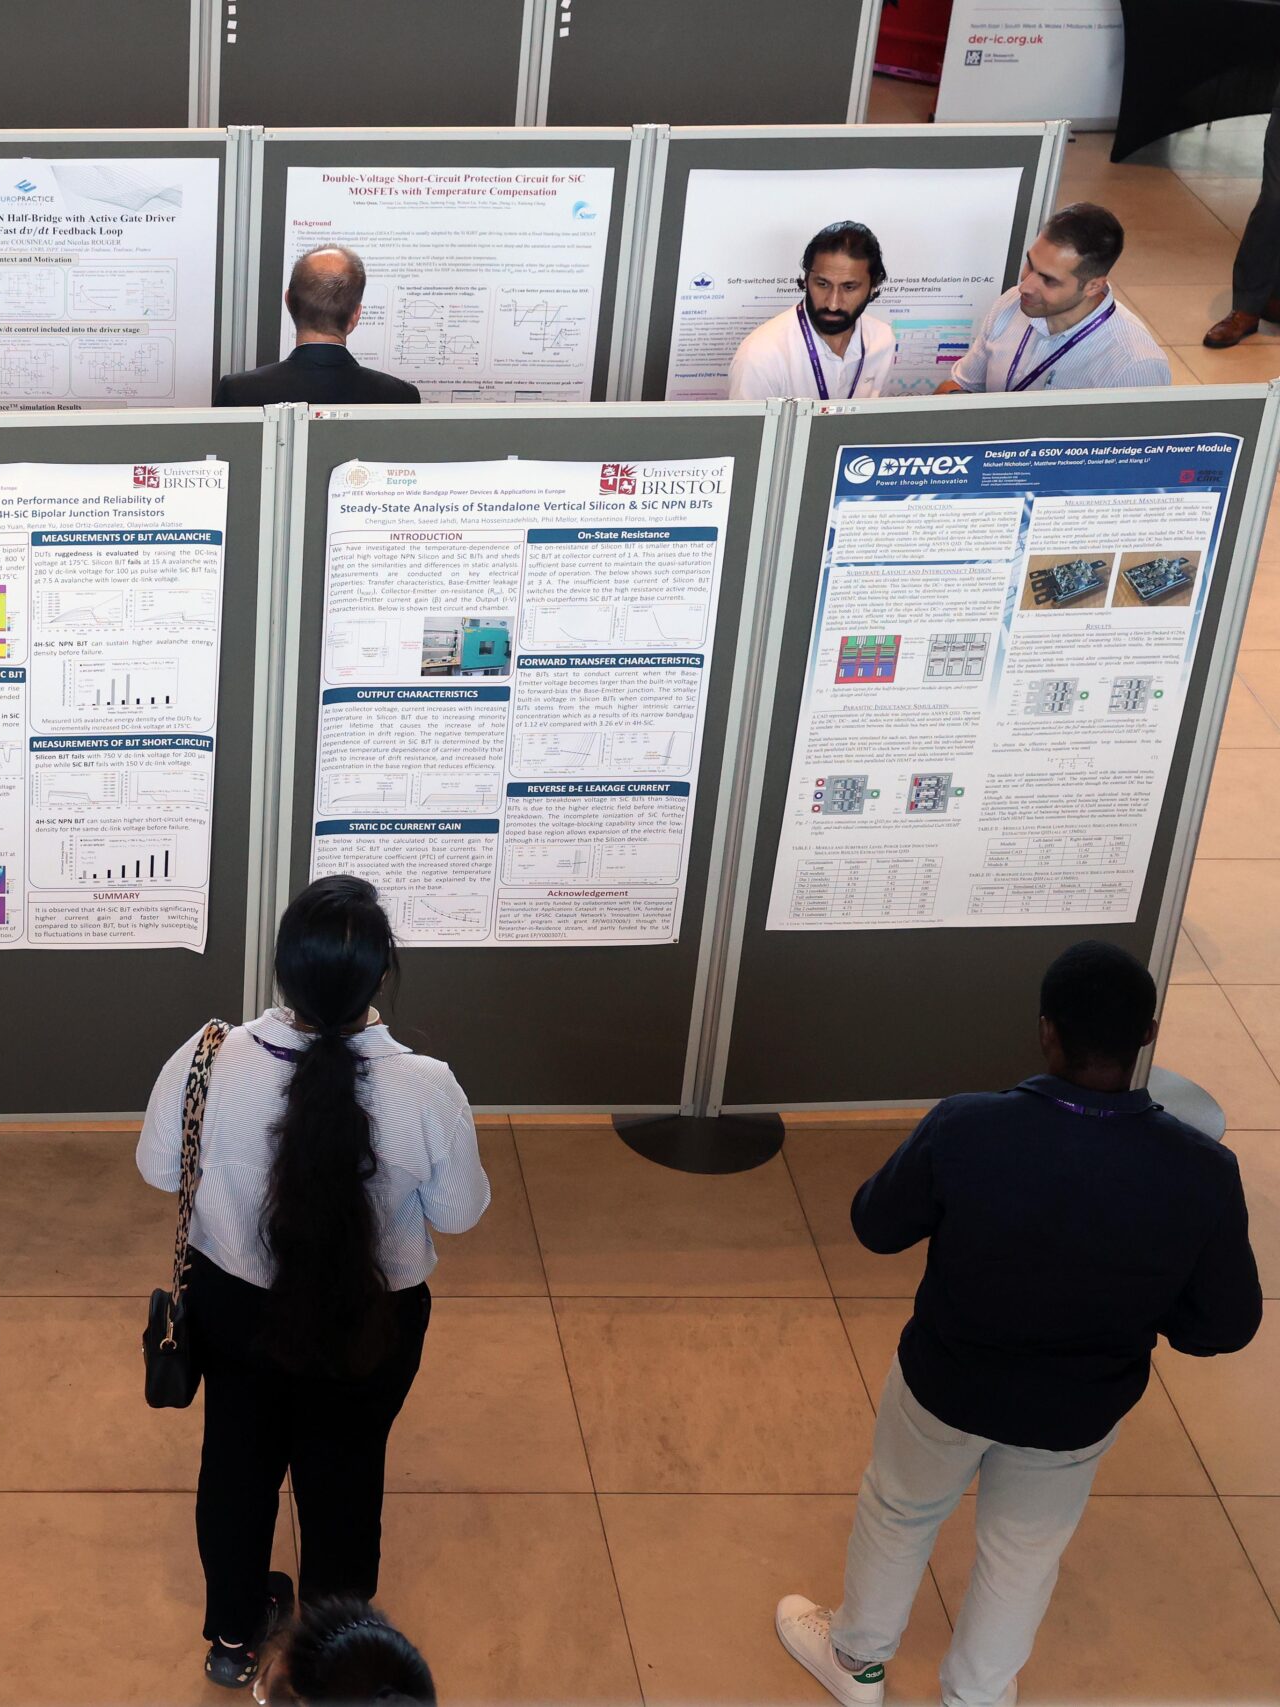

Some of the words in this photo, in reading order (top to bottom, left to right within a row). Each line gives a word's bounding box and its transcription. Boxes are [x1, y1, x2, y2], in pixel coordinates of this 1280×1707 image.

[968, 34, 1042, 45] der-ic.org.uk
[322, 174, 394, 184] Double-Voltage
[464, 174, 511, 182] Protection
[426, 187, 486, 196] Temperature
[489, 188, 556, 197] Compensation
[8, 214, 62, 223] Half-Bridge
[19, 226, 48, 235] dv/dt
[100, 227, 122, 236] Loop
[985, 450, 1016, 458] Design
[1091, 446, 1141, 455] Half-bridge
[1196, 444, 1231, 452] Module
[643, 467, 707, 479] University
[711, 465, 726, 476] of
[642, 480, 724, 494] BRISTOL
[17, 496, 79, 504] Performance
[103, 495, 151, 505] Reliability
[154, 495, 164, 503] of
[340, 503, 410, 514] Steady-State
[413, 502, 458, 513] Analysis
[462, 502, 474, 511] of
[477, 502, 539, 511] Standalone
[544, 501, 585, 510] Vertical
[589, 501, 624, 510] Silicon
[629, 500, 637, 509] &
[641, 500, 658, 509] SiC
[662, 500, 686, 508] NPN
[690, 499, 712, 508] BJTs
[32, 509, 65, 518] Bipolar
[92, 892, 140, 900] SUMMARY
[547, 888, 628, 898] Acknowledgement
